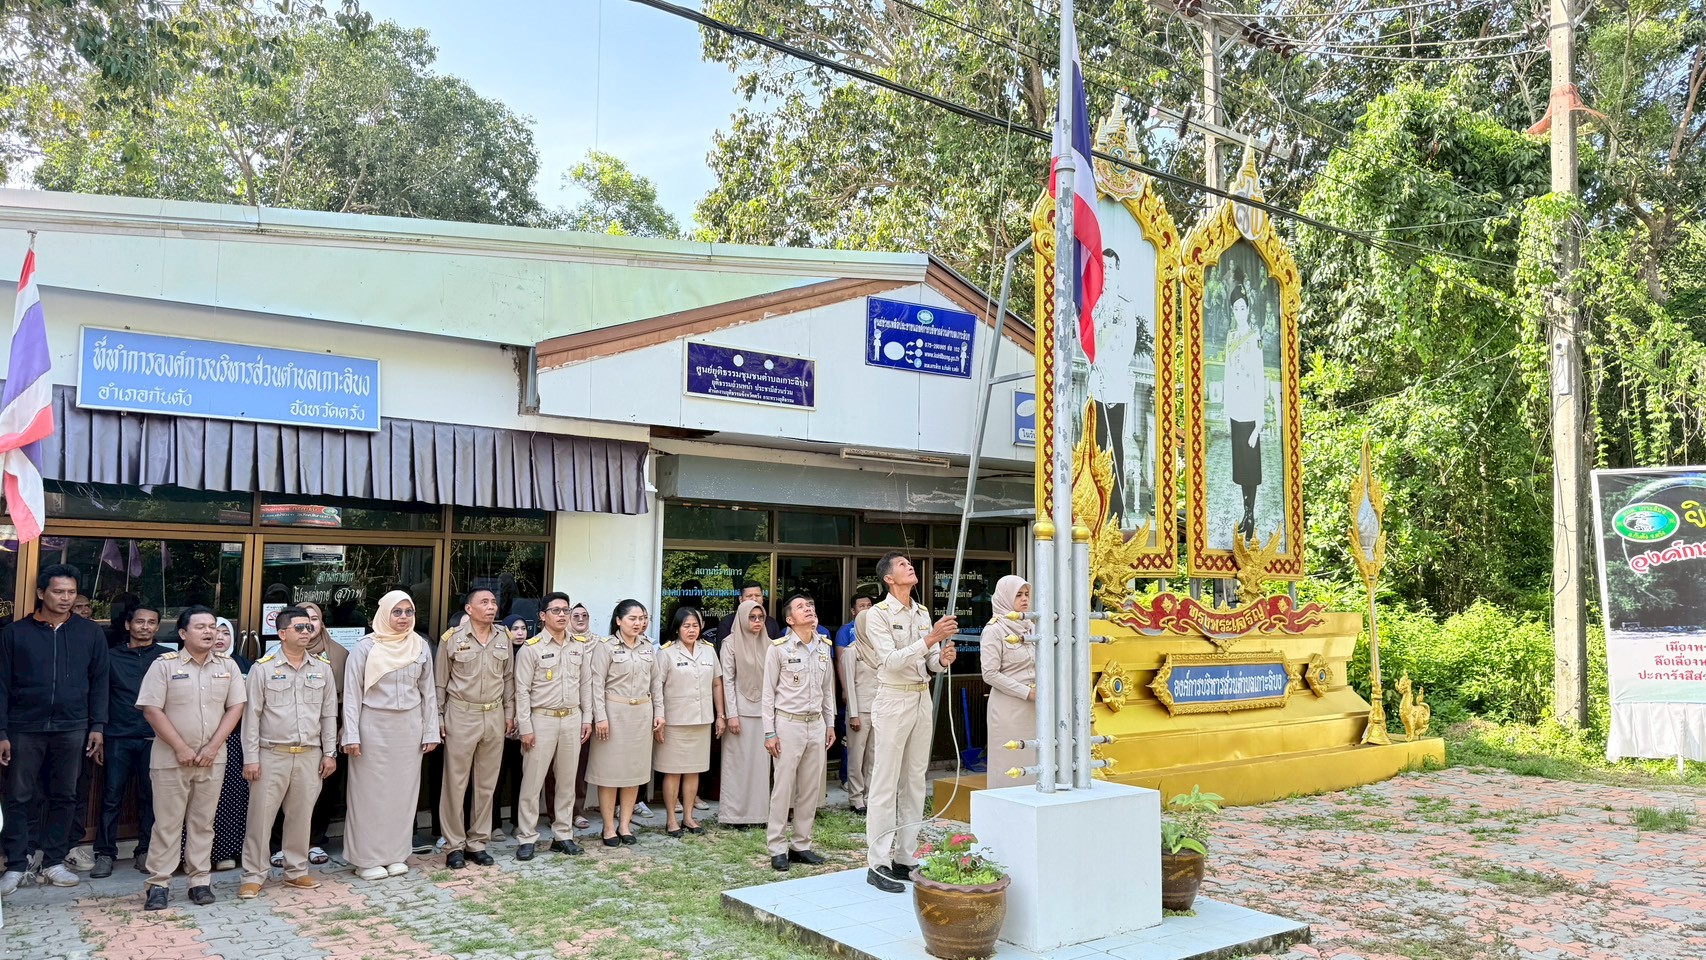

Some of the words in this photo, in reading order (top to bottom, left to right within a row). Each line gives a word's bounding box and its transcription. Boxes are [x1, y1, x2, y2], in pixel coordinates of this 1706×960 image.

[93, 336, 370, 397] ที่ทำการองค์การบริหารส่วนตำบลเกาะลิบง
[696, 364, 809, 387] ศูนย์ยุติธรรมชุมชนตำบลเกาะลิบง
[98, 383, 192, 407] อำเภอกันตัง
[290, 400, 365, 421] จังหวัดตรัง
[695, 563, 742, 576] สถานที่ราชการ
[335, 587, 365, 607] สุภาพ
[1189, 603, 1265, 632] ทรงพระเจริญ
[1666, 641, 1706, 652] เมืองพ
[1174, 669, 1282, 698] องค์การบริหารส่วนตำบลเกาะลิบง
[1638, 669, 1706, 681] ปะการังสีส
